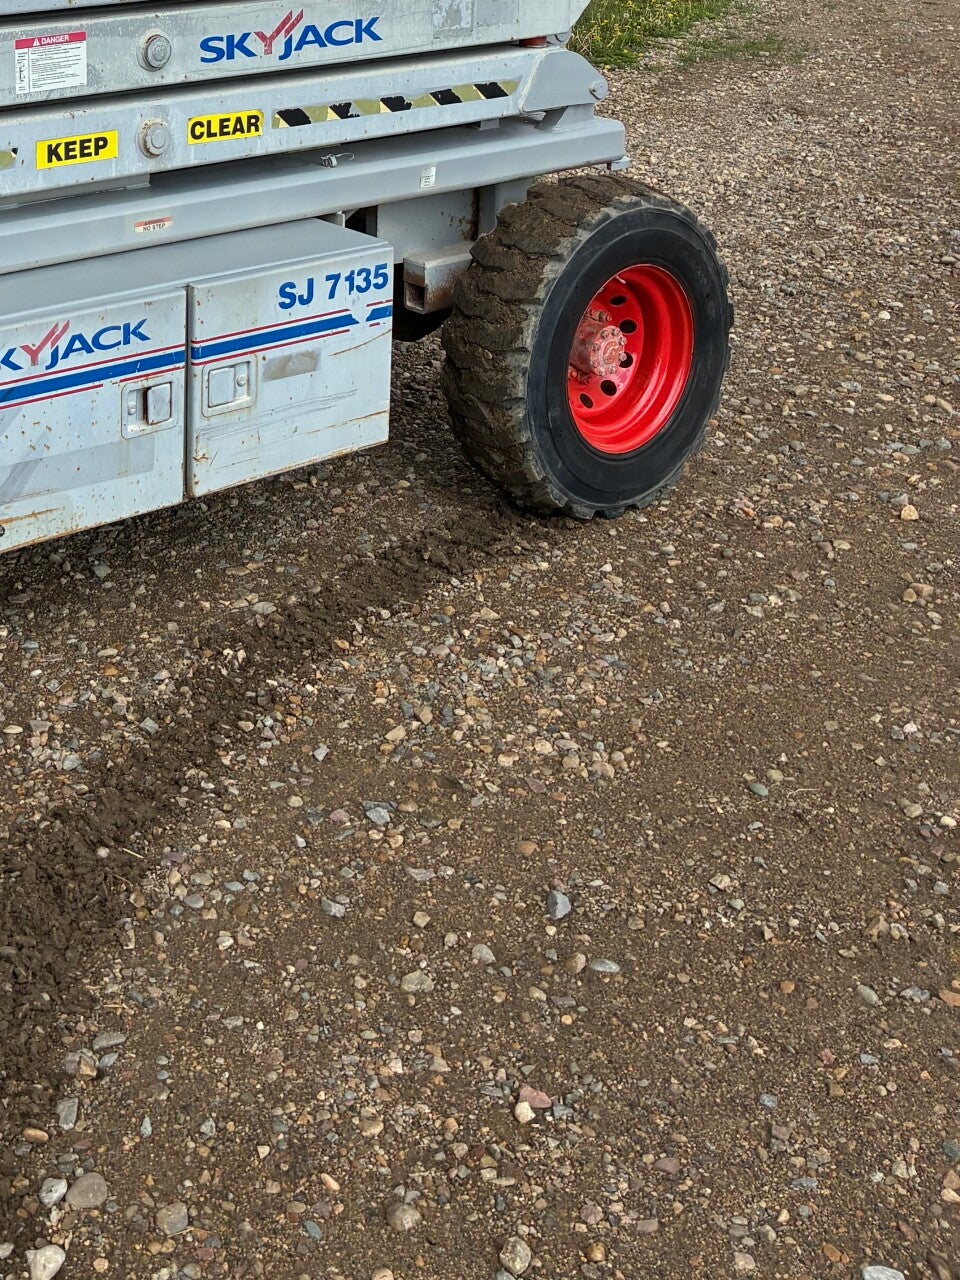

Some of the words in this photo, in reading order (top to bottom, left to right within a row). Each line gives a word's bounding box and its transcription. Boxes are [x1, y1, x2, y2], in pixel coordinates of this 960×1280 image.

[41, 34, 70, 45] DANGER
[199, 9, 383, 64] SKYJACK
[46, 136, 108, 164] KEEP
[189, 114, 260, 140] CLEAR
[152, 222, 166, 231] STEP
[278, 278, 315, 310] SJ
[325, 263, 389, 300] 7135
